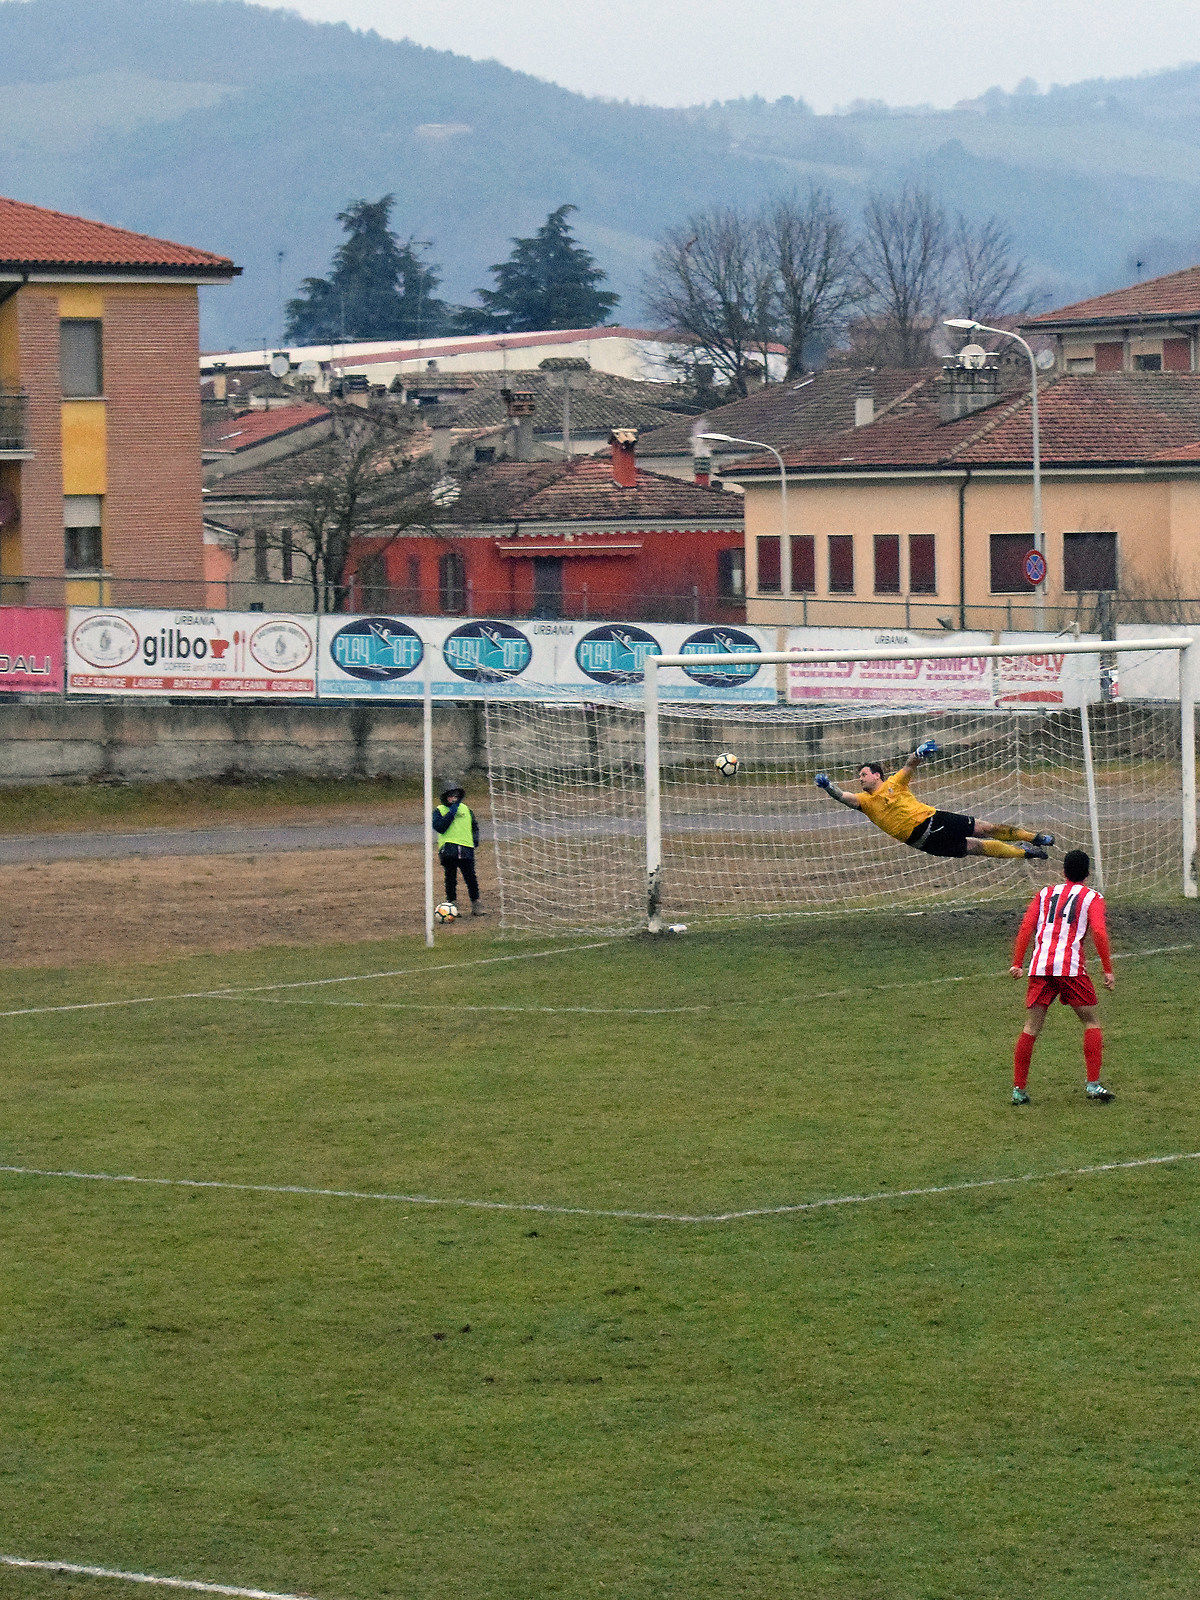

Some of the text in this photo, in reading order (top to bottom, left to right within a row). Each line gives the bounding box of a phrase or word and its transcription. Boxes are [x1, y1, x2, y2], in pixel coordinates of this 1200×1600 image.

[175, 616, 215, 626] URBANIA
[534, 624, 574, 635] URBANIA
[143, 628, 208, 666] gilbo
[336, 637, 419, 665] PLAY OFF
[874, 635, 909, 645] URBANIA
[164, 662, 191, 671] COFFEE
[502, 641, 527, 667] OFF
[581, 643, 611, 668] PLAY
[1046, 893, 1080, 924] 14
